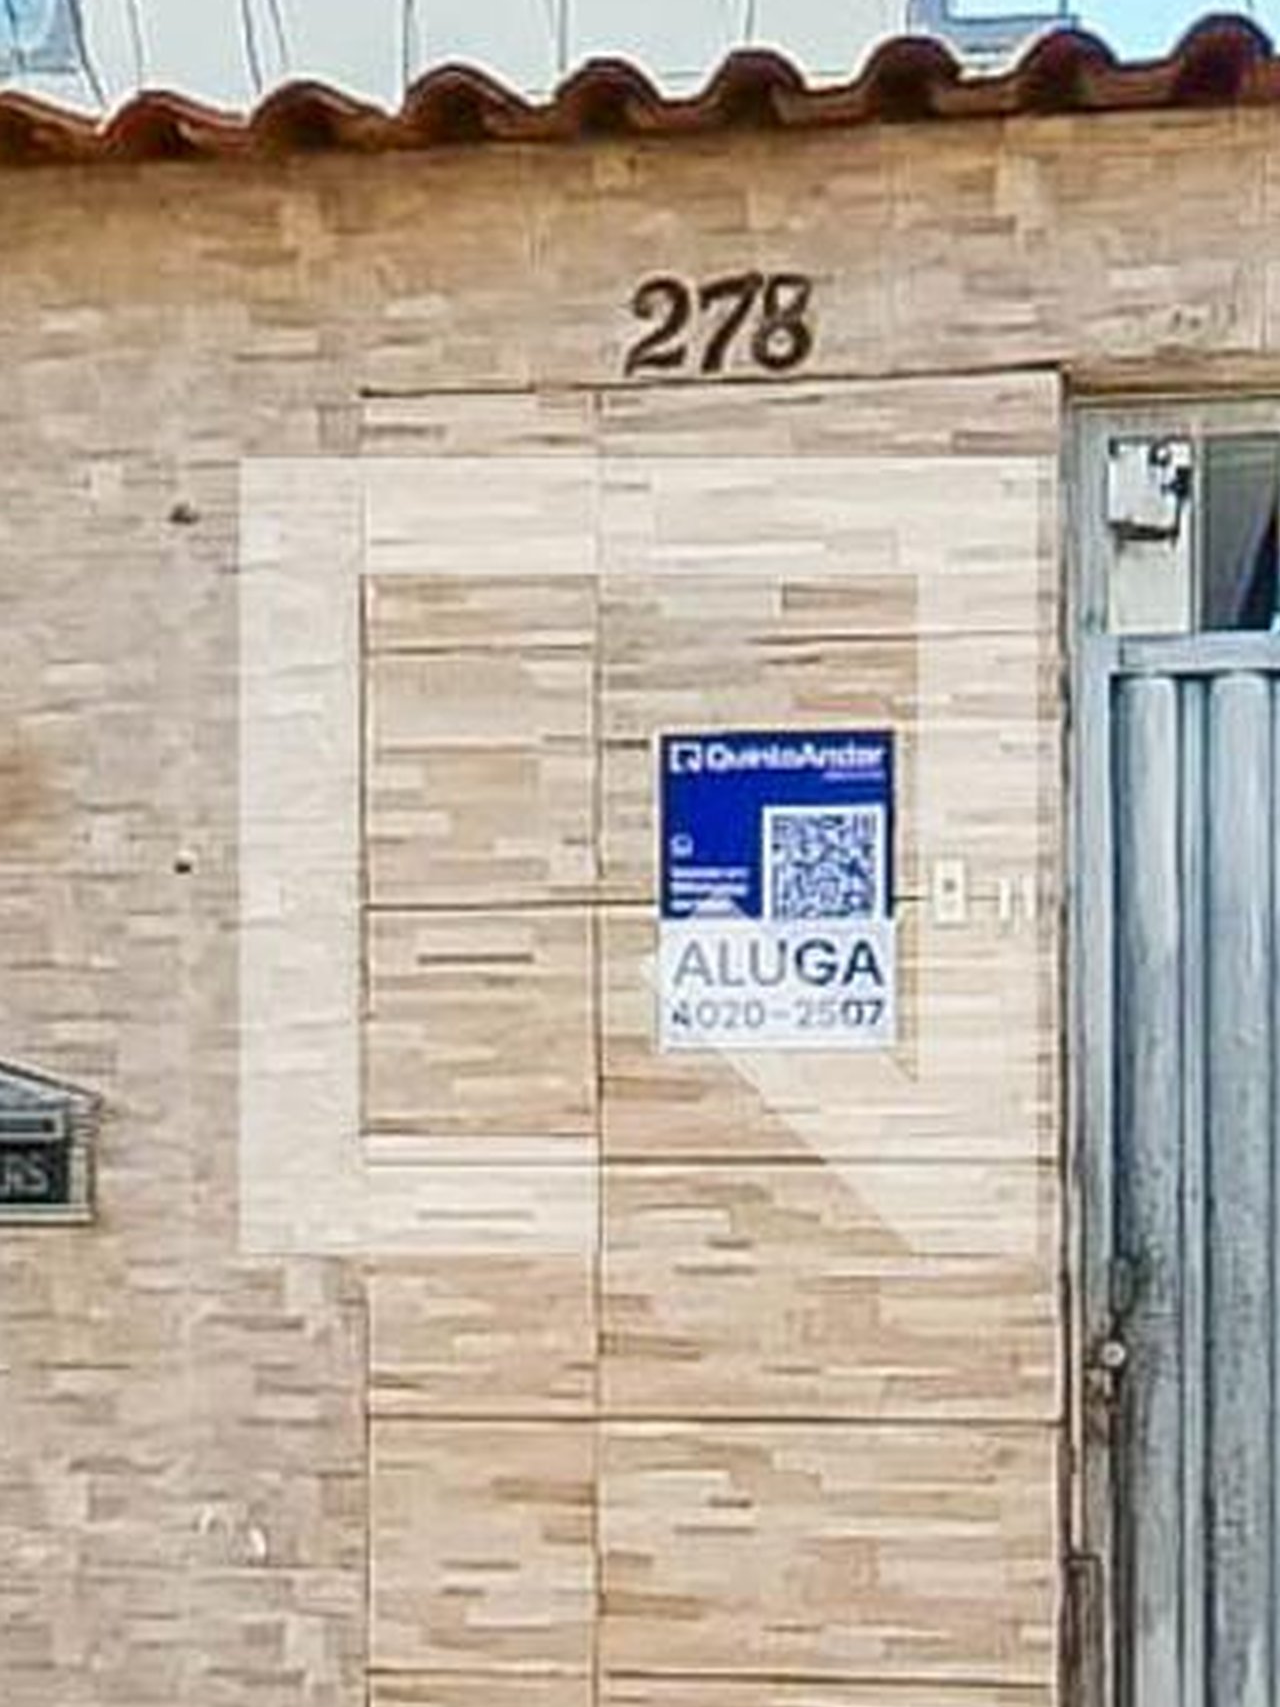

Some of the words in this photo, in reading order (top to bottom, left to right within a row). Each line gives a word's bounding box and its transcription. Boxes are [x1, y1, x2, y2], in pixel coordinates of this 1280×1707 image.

[624, 270, 813, 375] 278
[672, 939, 884, 987] ALUGA
[671, 999, 884, 1029] 4020-2507
